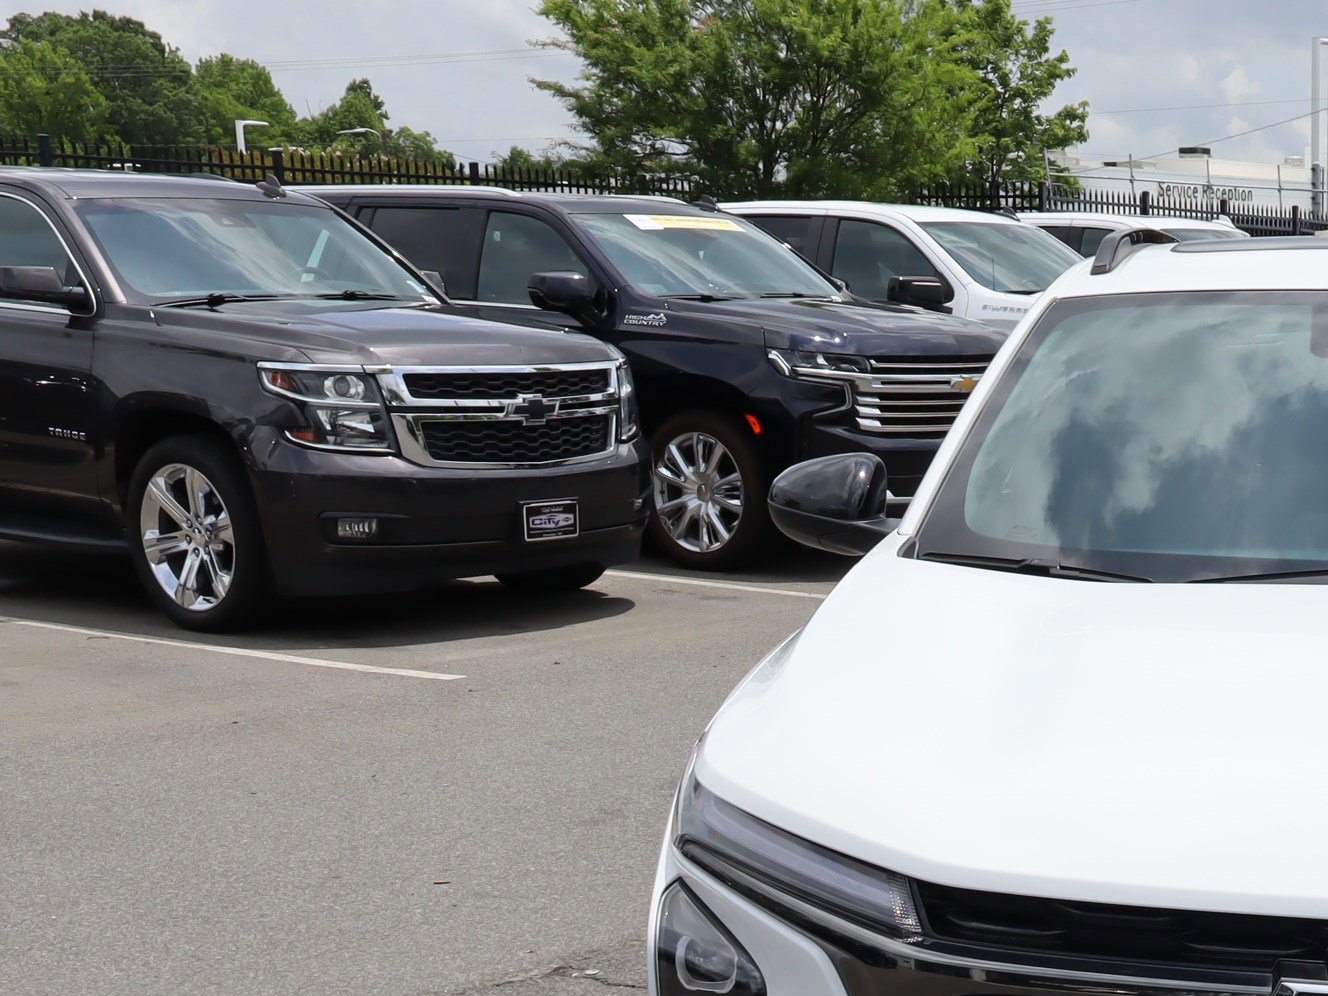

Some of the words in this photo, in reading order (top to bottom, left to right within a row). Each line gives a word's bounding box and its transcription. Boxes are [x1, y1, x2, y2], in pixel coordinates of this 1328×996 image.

[1158, 181, 1199, 199] Service
[1202, 184, 1254, 202] Reception
[48, 427, 86, 440] TAHOE
